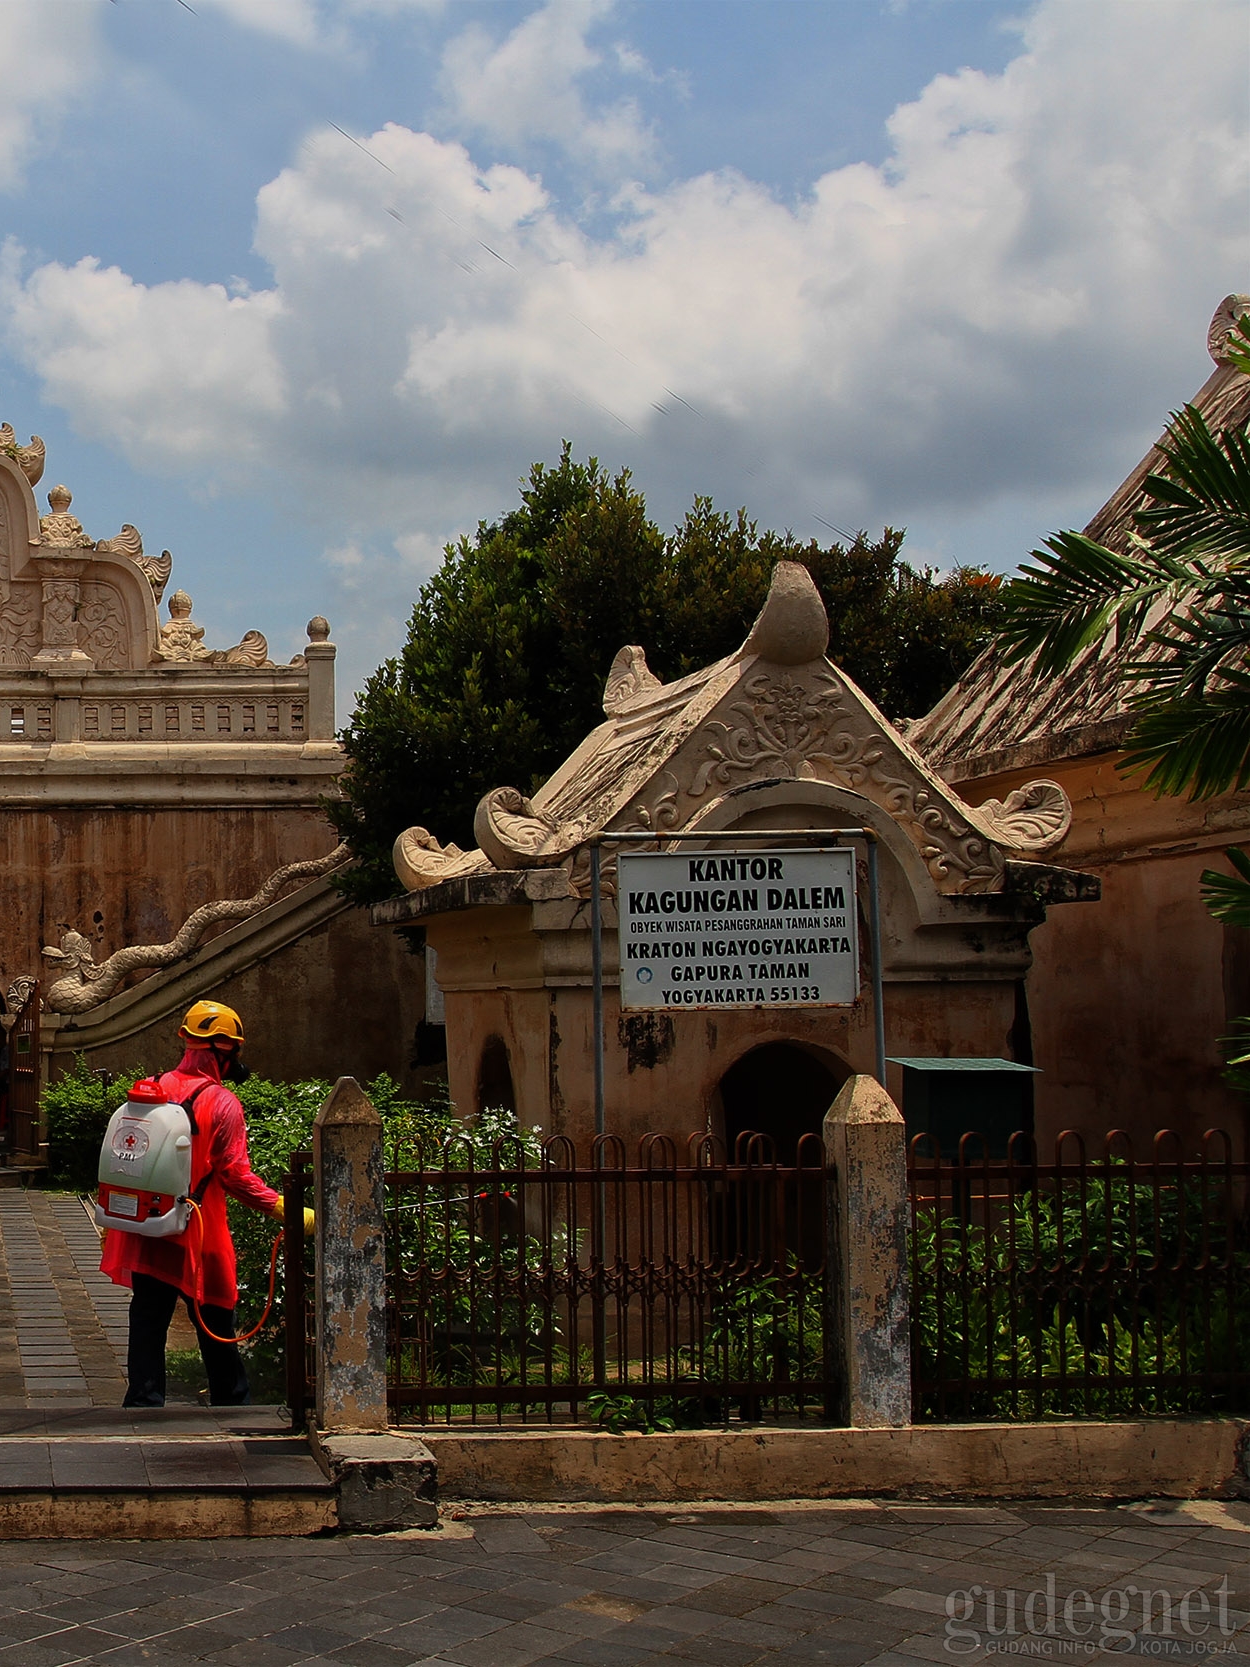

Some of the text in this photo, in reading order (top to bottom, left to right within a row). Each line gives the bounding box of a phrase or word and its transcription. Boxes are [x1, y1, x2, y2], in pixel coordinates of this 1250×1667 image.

[689, 858, 783, 882] KANTOR
[629, 886, 845, 915] KAGUNGAN DALEM
[630, 915, 846, 934] OBYEK WISATA PESANGGRAHAN TAMAN SARI
[627, 937, 851, 960] KRATON NGAYOGYAKARTA
[671, 962, 810, 982] GAPURA TAMAN
[662, 985, 820, 1004] YOGYAKARTA 55133
